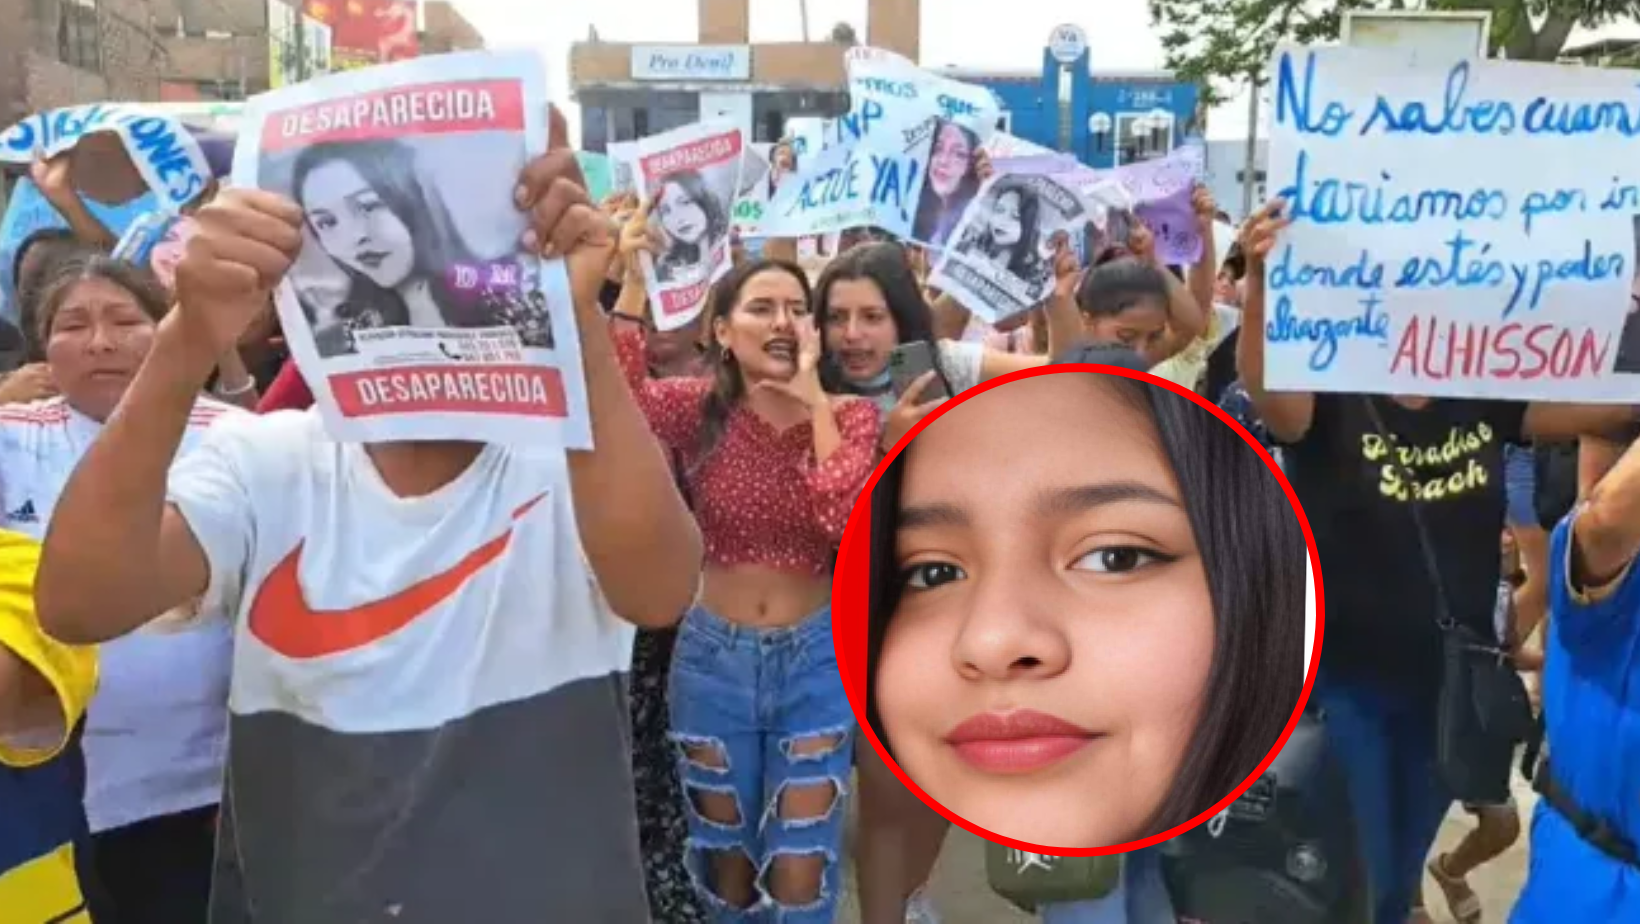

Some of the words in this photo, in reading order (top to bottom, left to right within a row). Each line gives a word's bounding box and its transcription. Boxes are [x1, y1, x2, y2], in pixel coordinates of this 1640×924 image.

[282, 89, 495, 137] DESAPARECIDA
[1277, 51, 1352, 135] No
[1360, 60, 1515, 136] sabes
[1520, 188, 1588, 237] por
[1268, 244, 1385, 288] donde
[1394, 229, 1504, 286] estés
[1503, 263, 1529, 319] y
[1528, 239, 1625, 310] poder
[1389, 314, 1611, 379] ALHISSON
[355, 372, 548, 406] DESAPARECIDA
